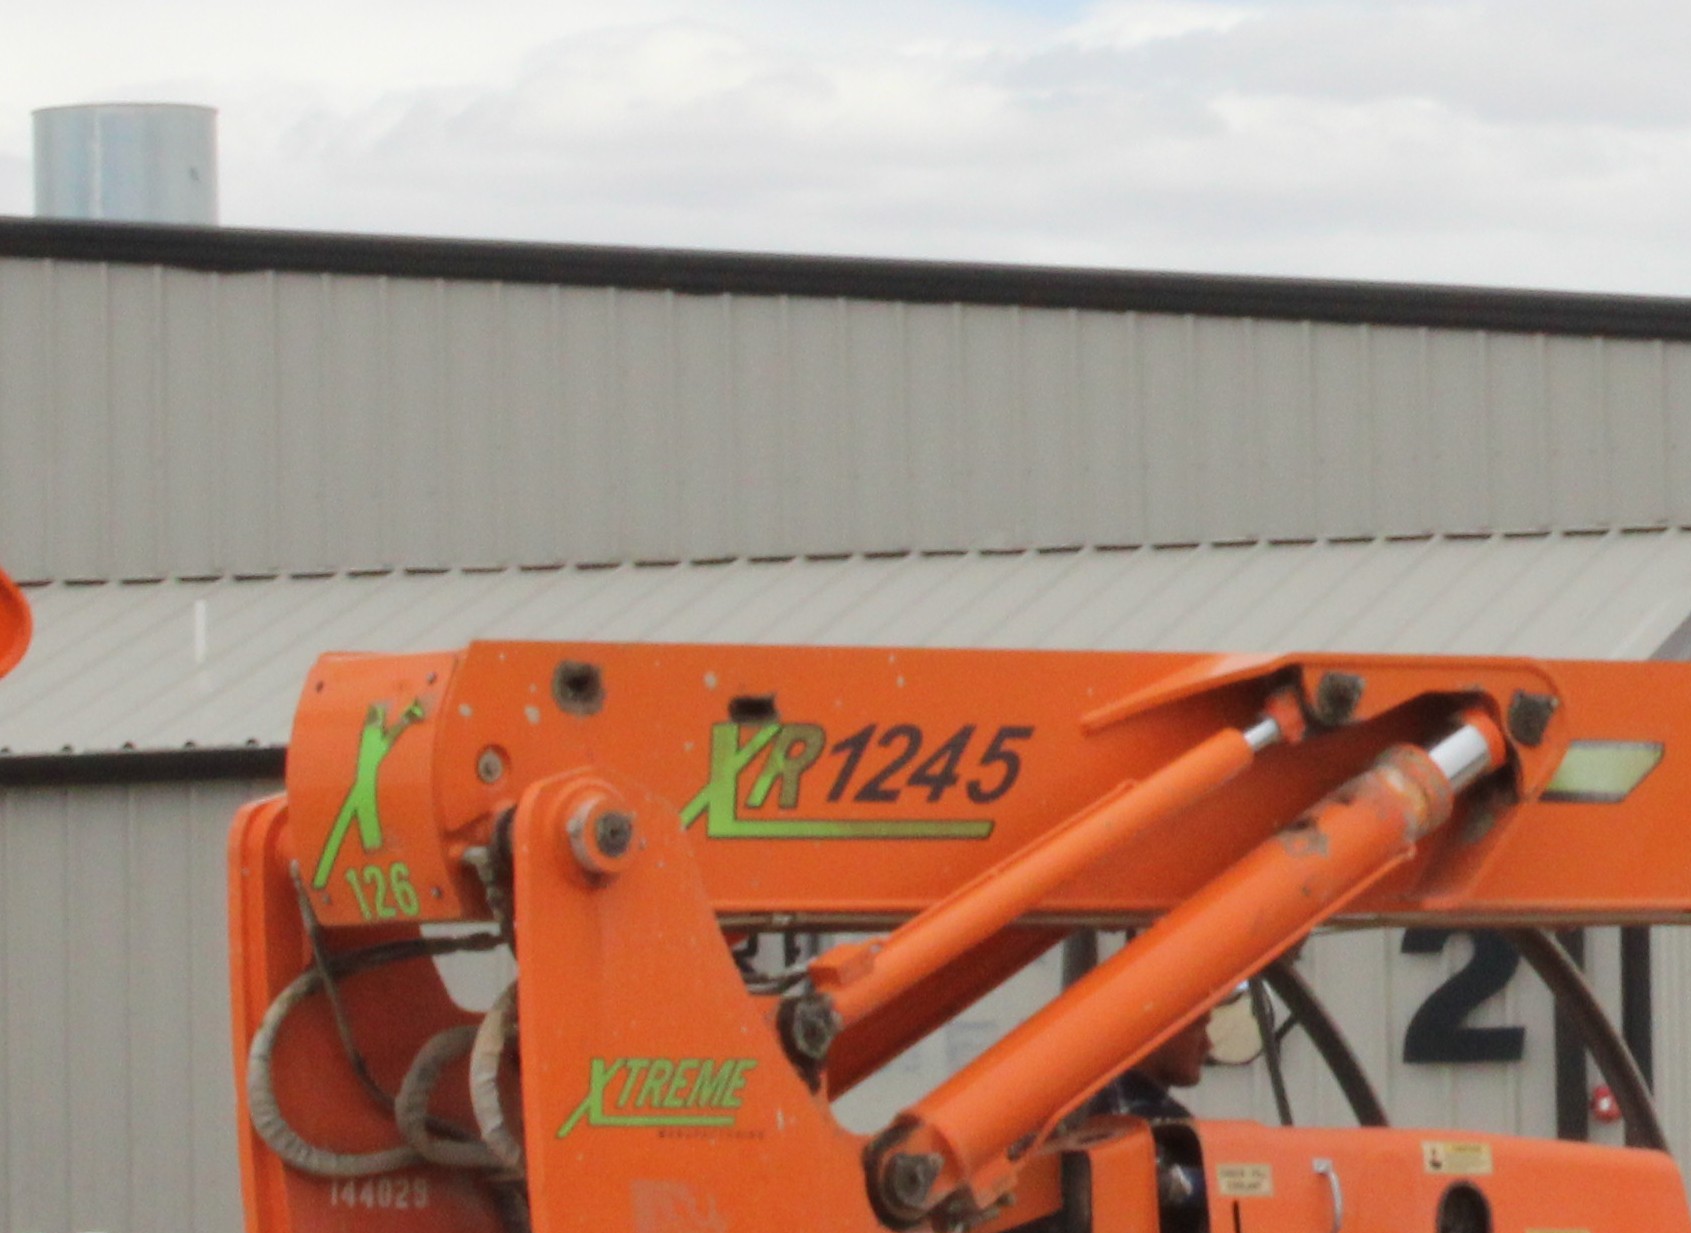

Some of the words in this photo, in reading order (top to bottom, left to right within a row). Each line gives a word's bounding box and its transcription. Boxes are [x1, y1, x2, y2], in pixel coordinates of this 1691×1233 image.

[679, 722, 1035, 838] XR1245
[345, 861, 420, 921] 126
[1400, 926, 1526, 1064] 2
[556, 1058, 759, 1139] XTREME
